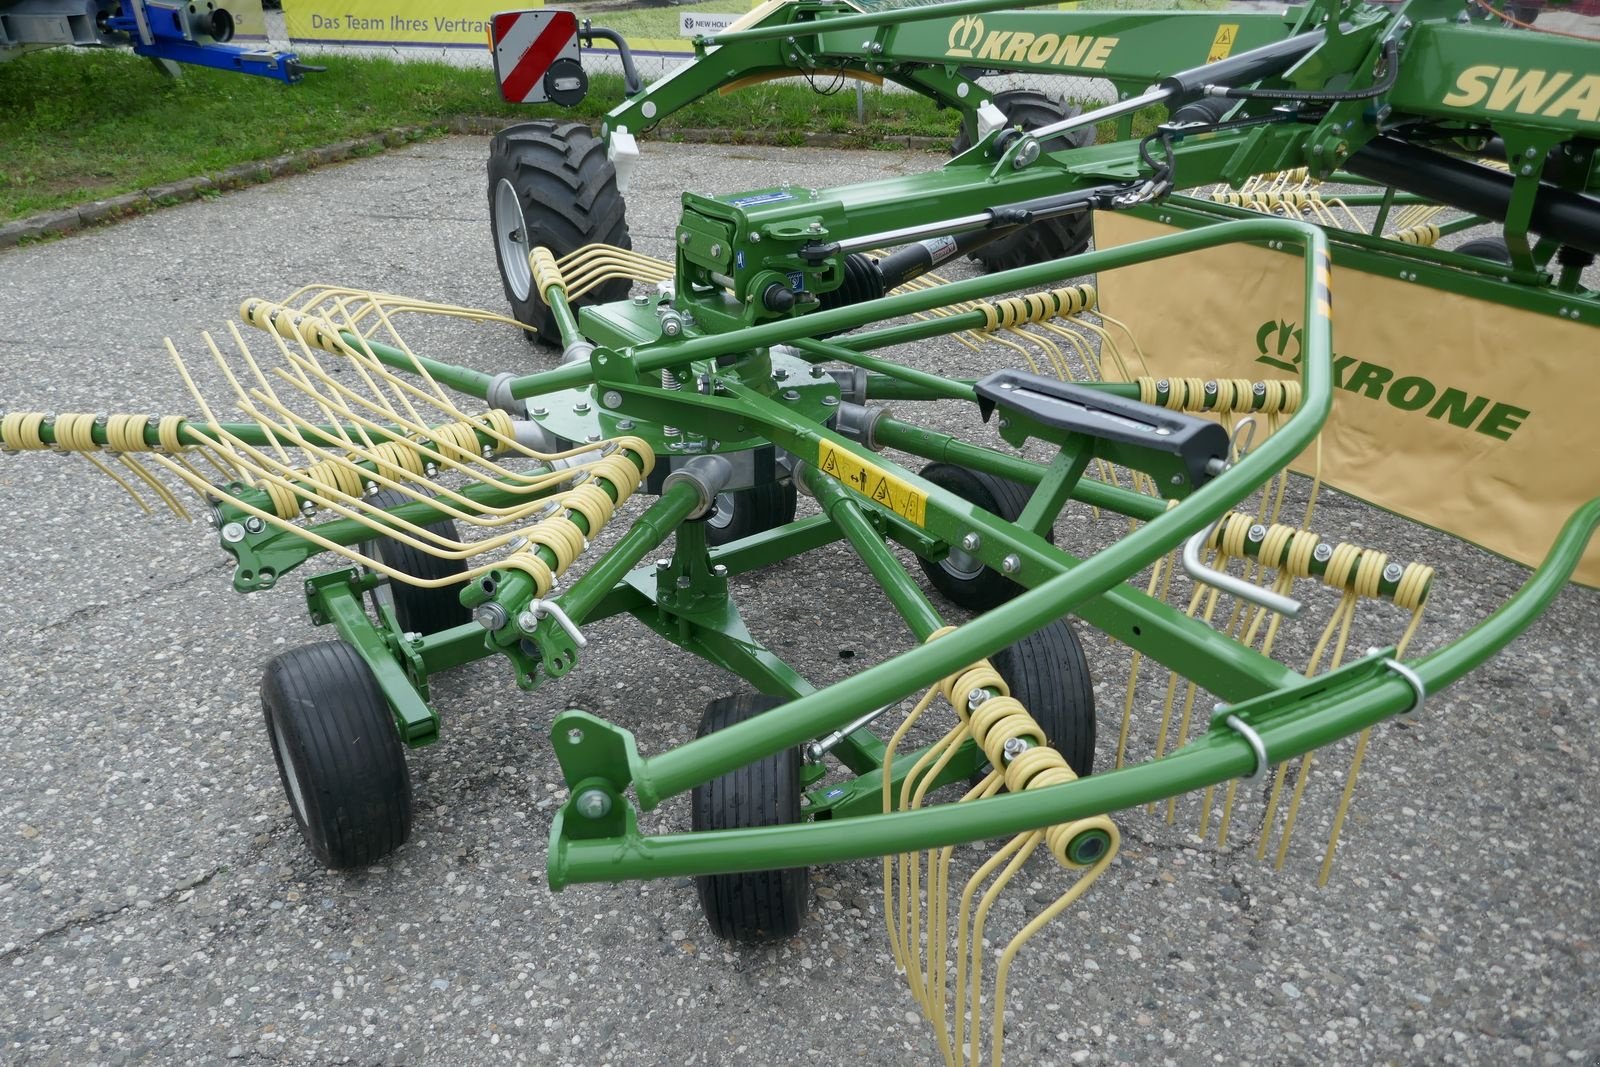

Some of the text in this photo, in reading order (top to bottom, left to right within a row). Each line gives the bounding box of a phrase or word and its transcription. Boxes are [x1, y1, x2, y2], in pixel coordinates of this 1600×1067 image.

[312, 14, 340, 30] Das
[345, 15, 385, 31] Team
[390, 15, 429, 33] Ihres
[695, 20, 733, 28] NEW HOLL
[977, 30, 1120, 69] KRONE
[1442, 65, 1600, 122] SWA
[1332, 352, 1531, 442] KRONE
